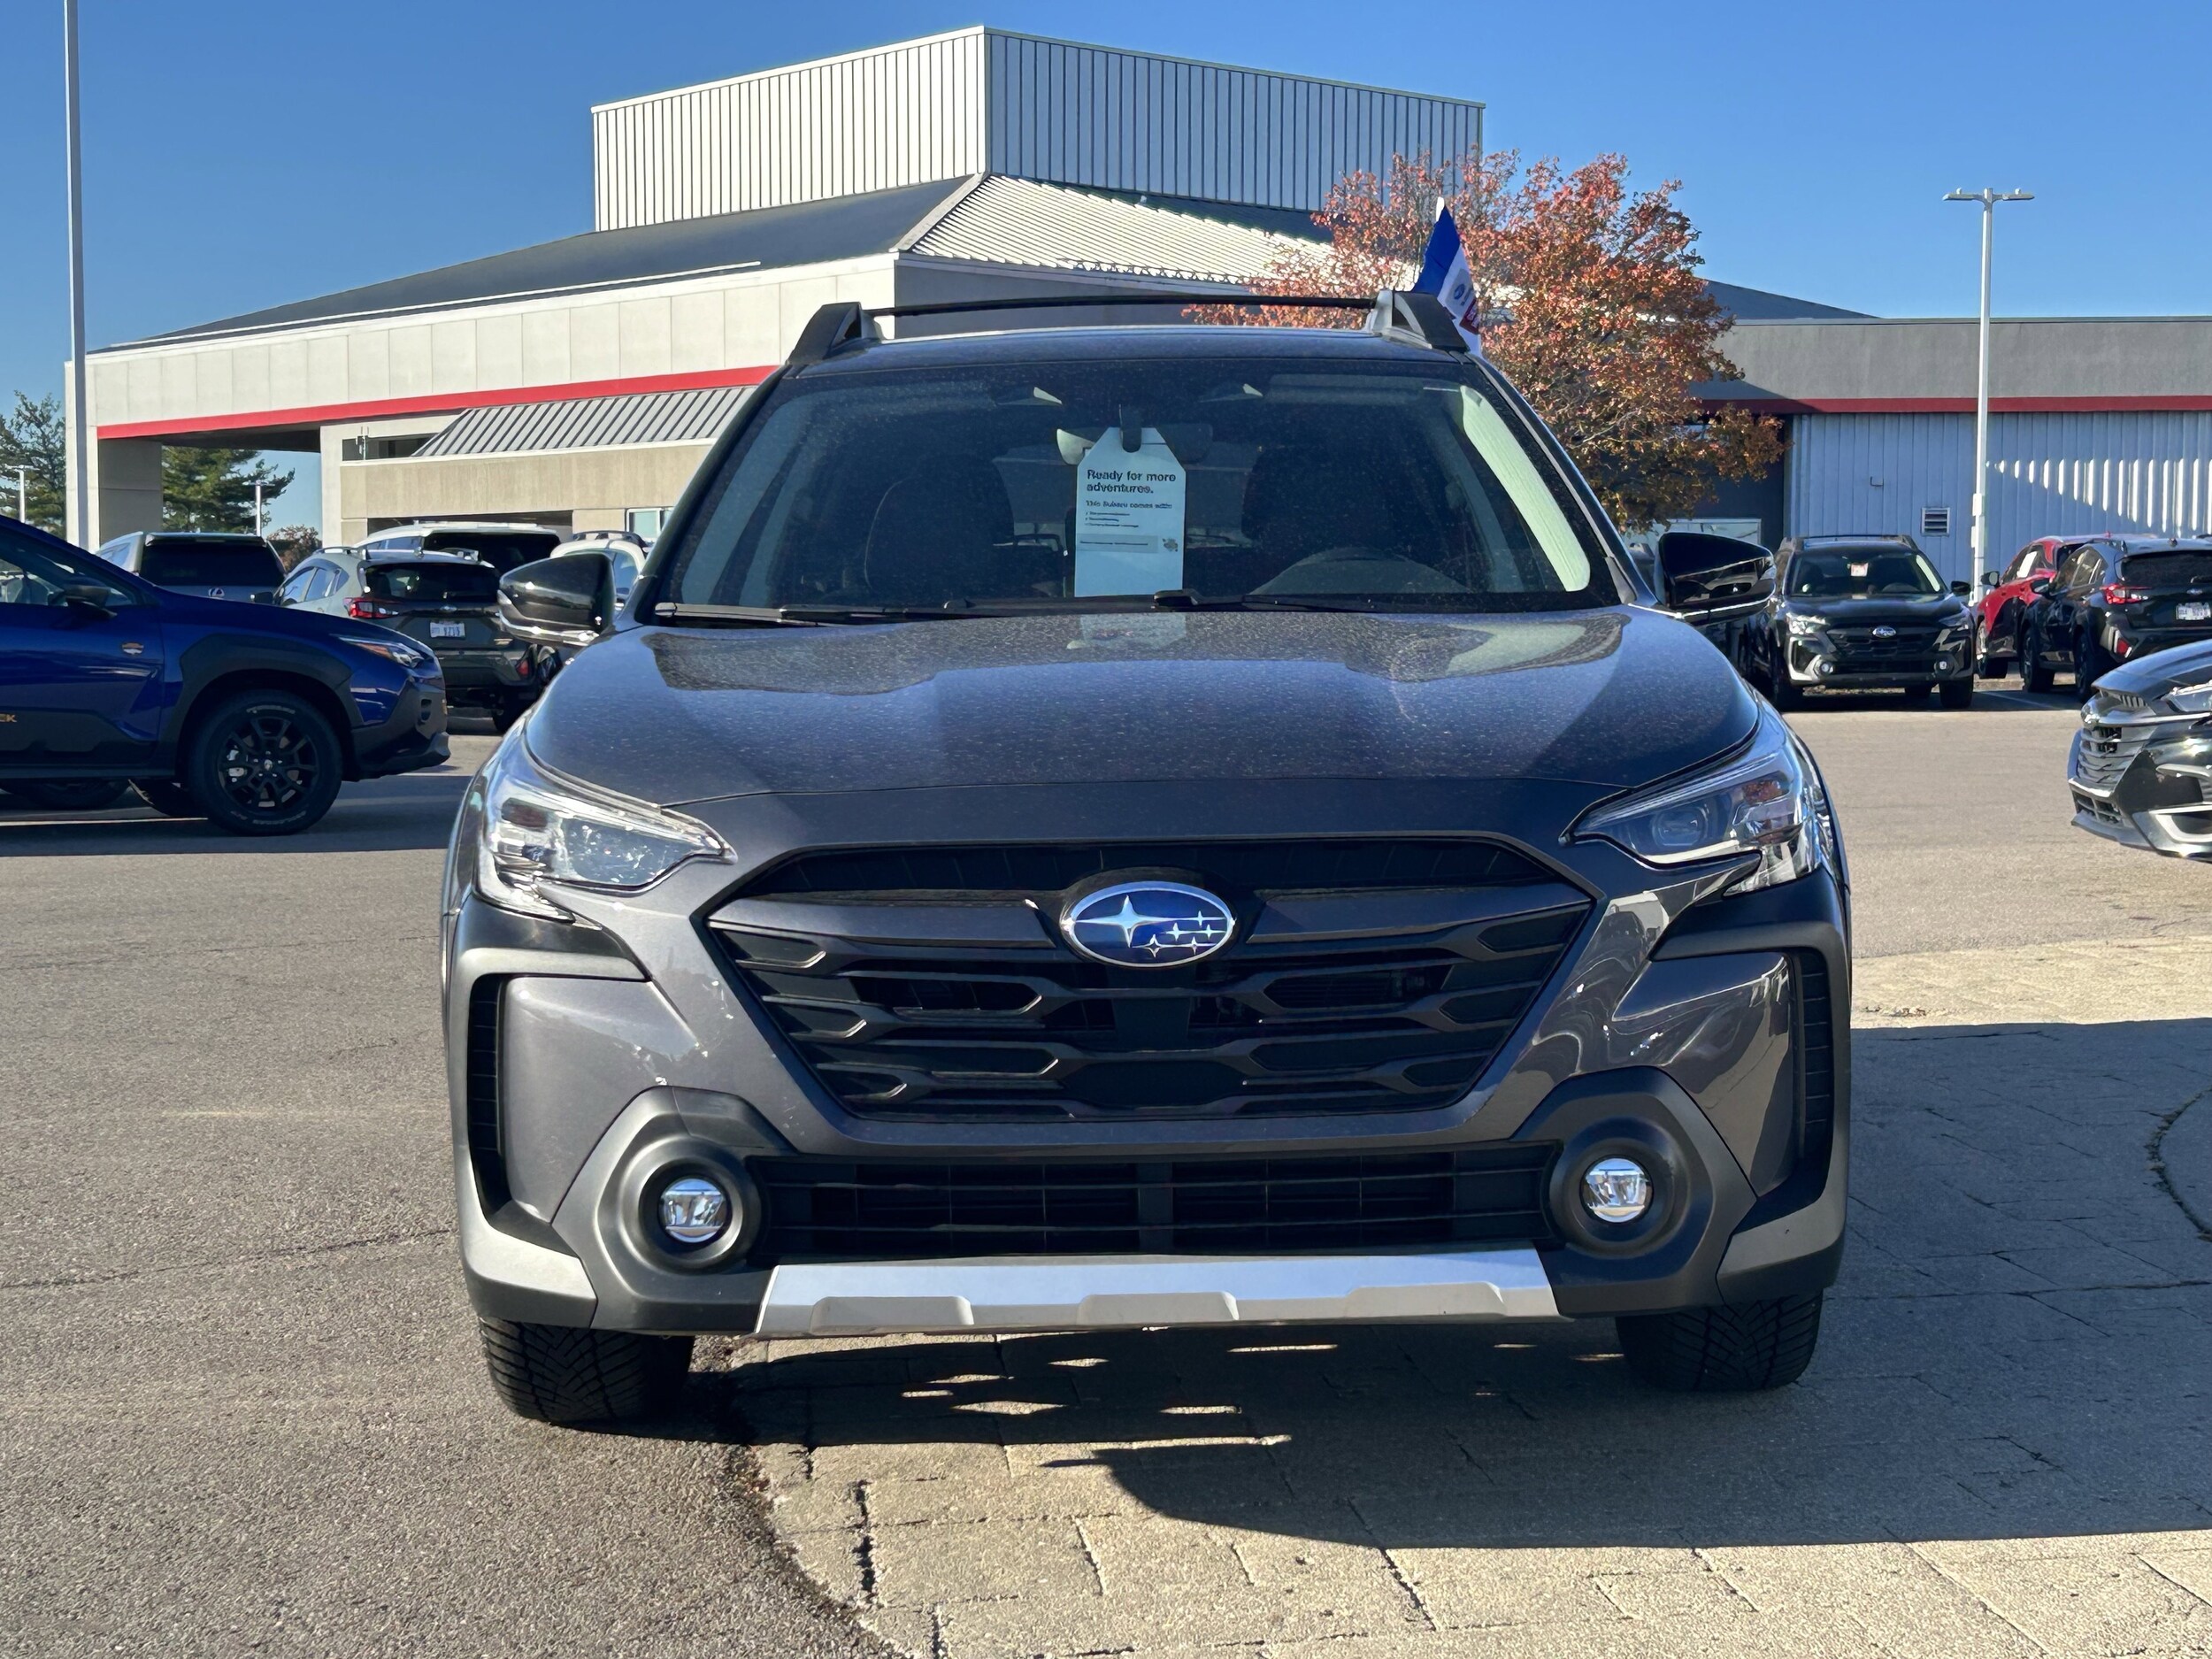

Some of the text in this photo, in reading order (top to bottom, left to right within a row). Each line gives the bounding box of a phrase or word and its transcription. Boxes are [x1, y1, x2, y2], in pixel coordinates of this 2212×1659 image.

[1087, 469, 1124, 481] Ready
[1126, 471, 1143, 480] for
[1087, 482, 1154, 494] adventures.
